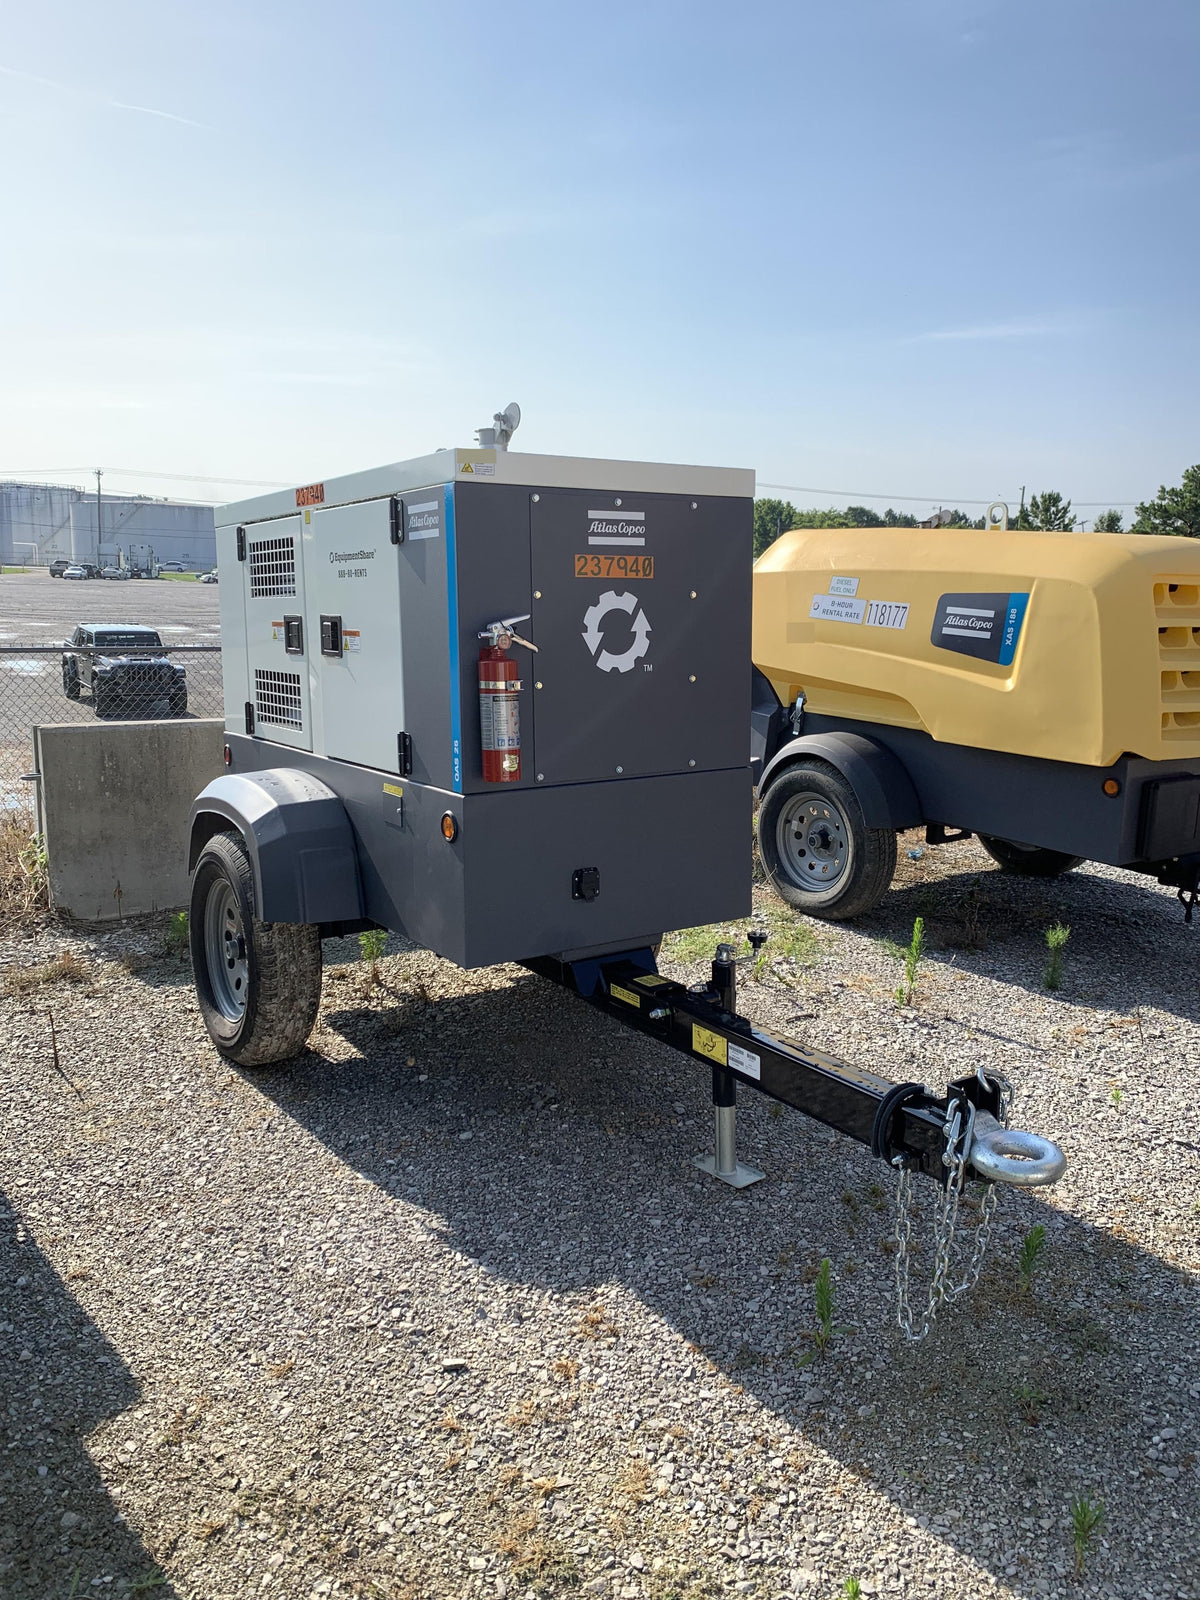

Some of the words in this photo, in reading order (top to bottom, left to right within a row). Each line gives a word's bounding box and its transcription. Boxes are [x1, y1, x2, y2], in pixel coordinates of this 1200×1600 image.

[296, 484, 324, 506] 237940
[408, 515, 423, 528] Atlas
[424, 514, 439, 527] Copco
[588, 521, 617, 534] Atlas
[618, 522, 645, 536] Copco
[335, 550, 374, 563] EquipmentShare
[576, 555, 652, 577] 237940
[822, 609, 843, 617] RENTAL
[867, 603, 908, 627] 118177
[944, 615, 968, 627] Atlas
[968, 618, 993, 629] Copco
[1005, 627, 1014, 645] XAS
